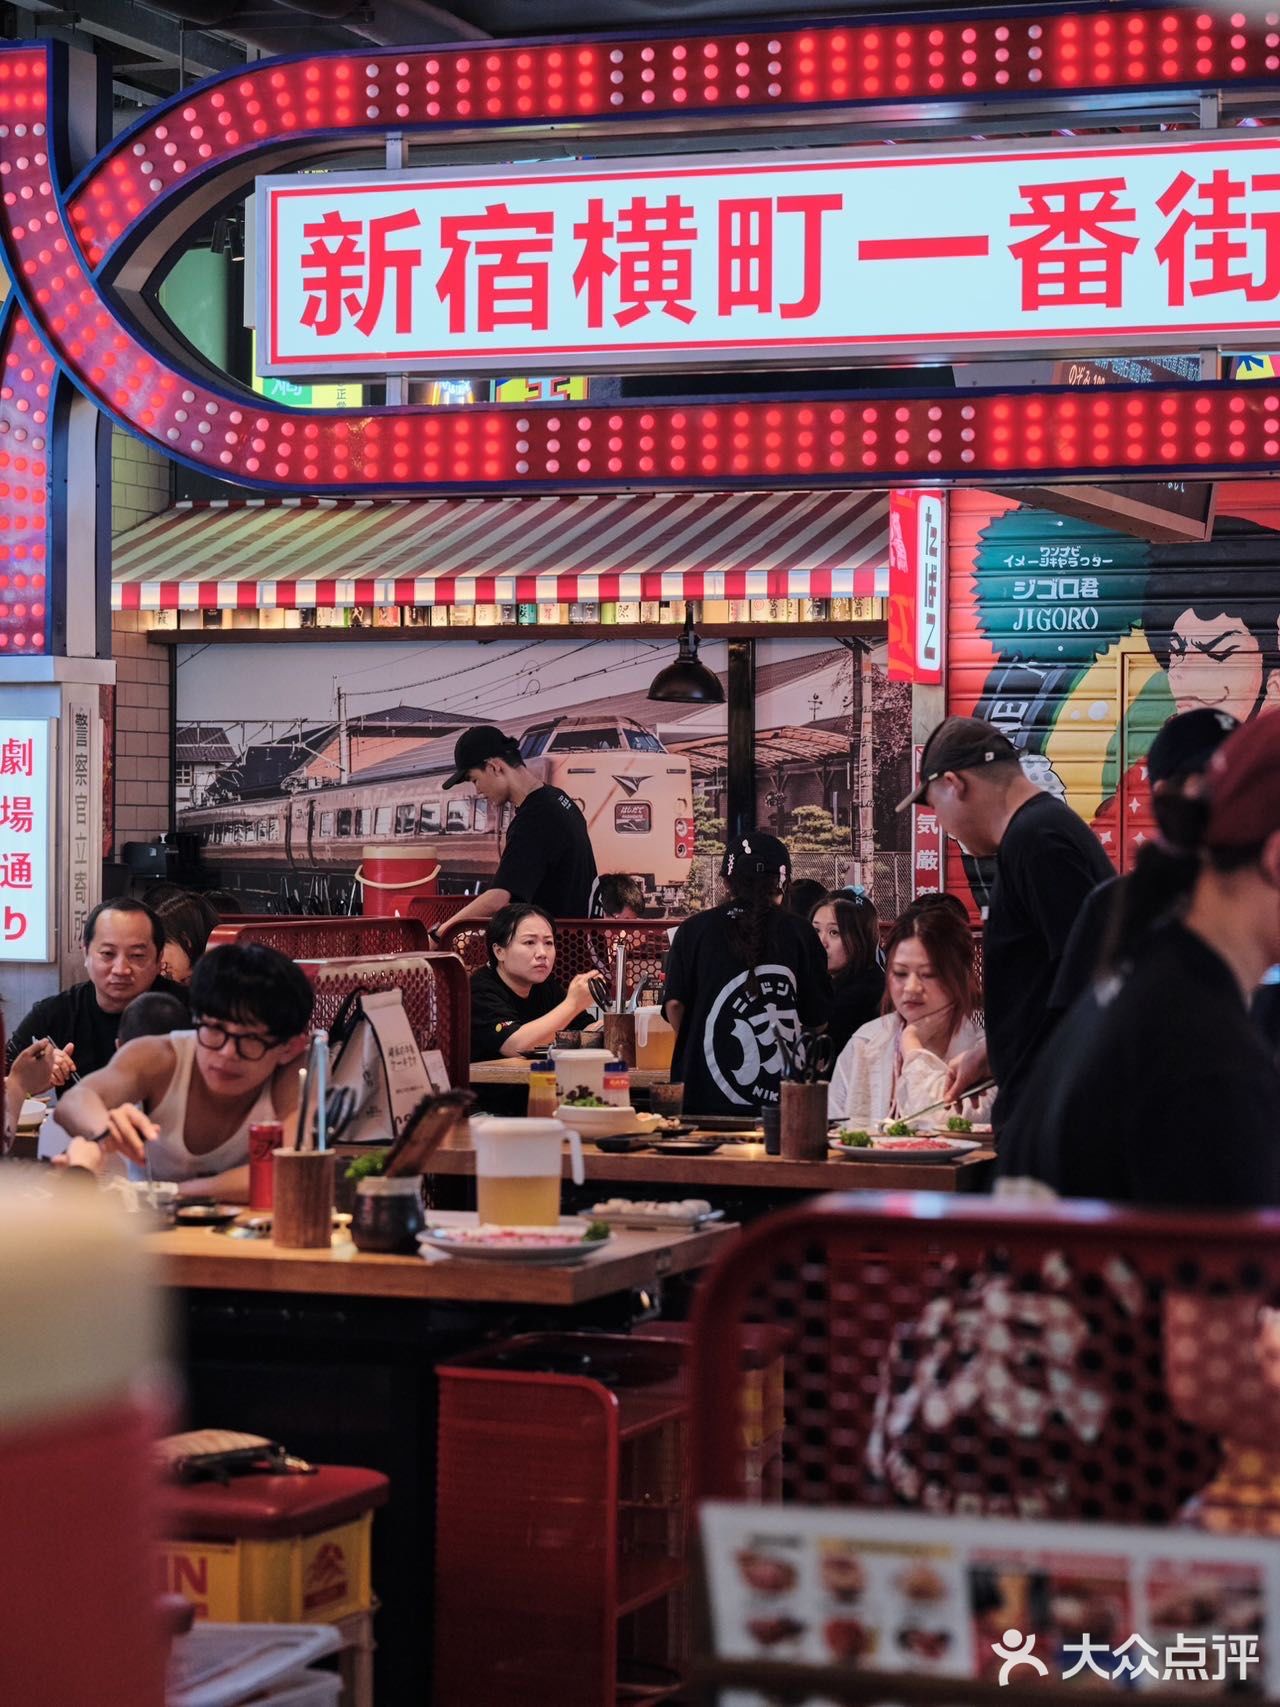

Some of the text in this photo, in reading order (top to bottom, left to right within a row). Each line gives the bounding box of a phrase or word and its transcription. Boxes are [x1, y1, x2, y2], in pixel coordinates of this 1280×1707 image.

[300, 169, 1280, 338] 新宿横町一番街
[1012, 578, 1099, 599] ジゴロ君
[1013, 607, 1099, 631] JIGORO
[0, 738, 34, 940] 劇場通り
